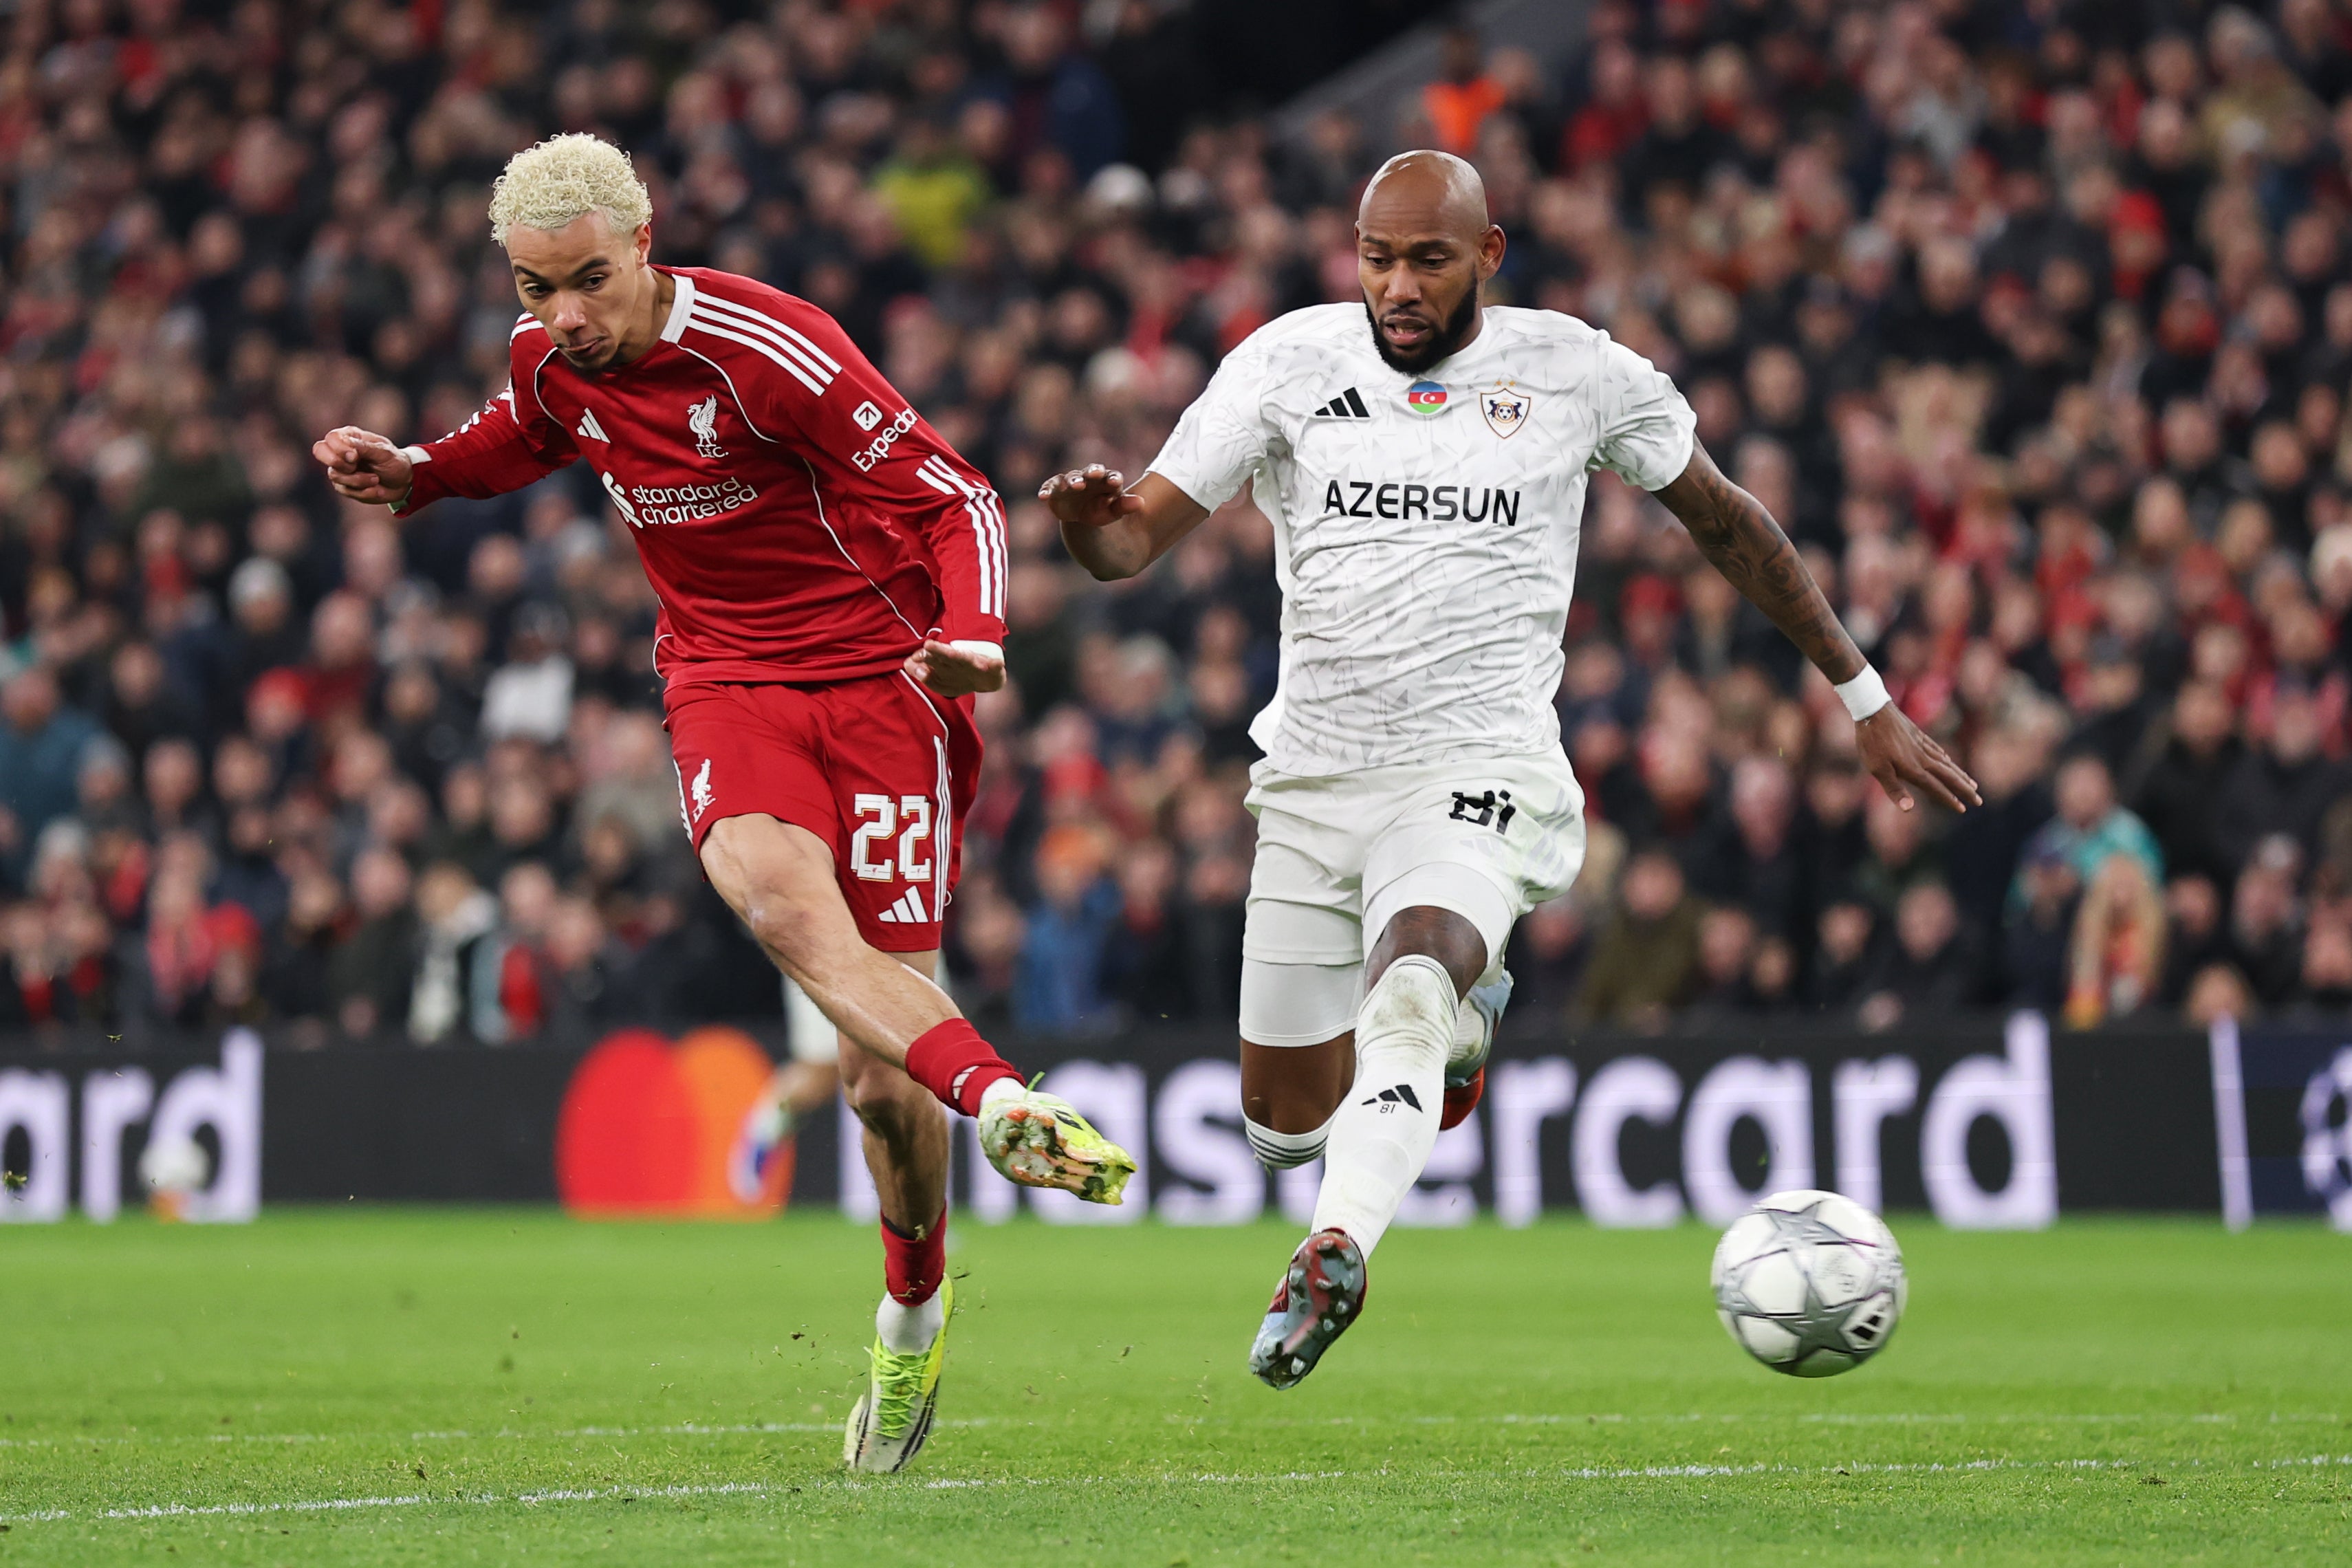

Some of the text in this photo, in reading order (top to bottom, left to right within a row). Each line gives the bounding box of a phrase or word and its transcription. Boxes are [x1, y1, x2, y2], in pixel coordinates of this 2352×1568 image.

[851, 408, 917, 472] Expeda
[632, 477, 741, 504] standard
[642, 484, 759, 524] chartered
[1324, 479, 1521, 526] AZERSUN
[851, 794, 932, 882] 22
[838, 1010, 2059, 1230] asrcard
[1380, 1104, 1396, 1113] 81
